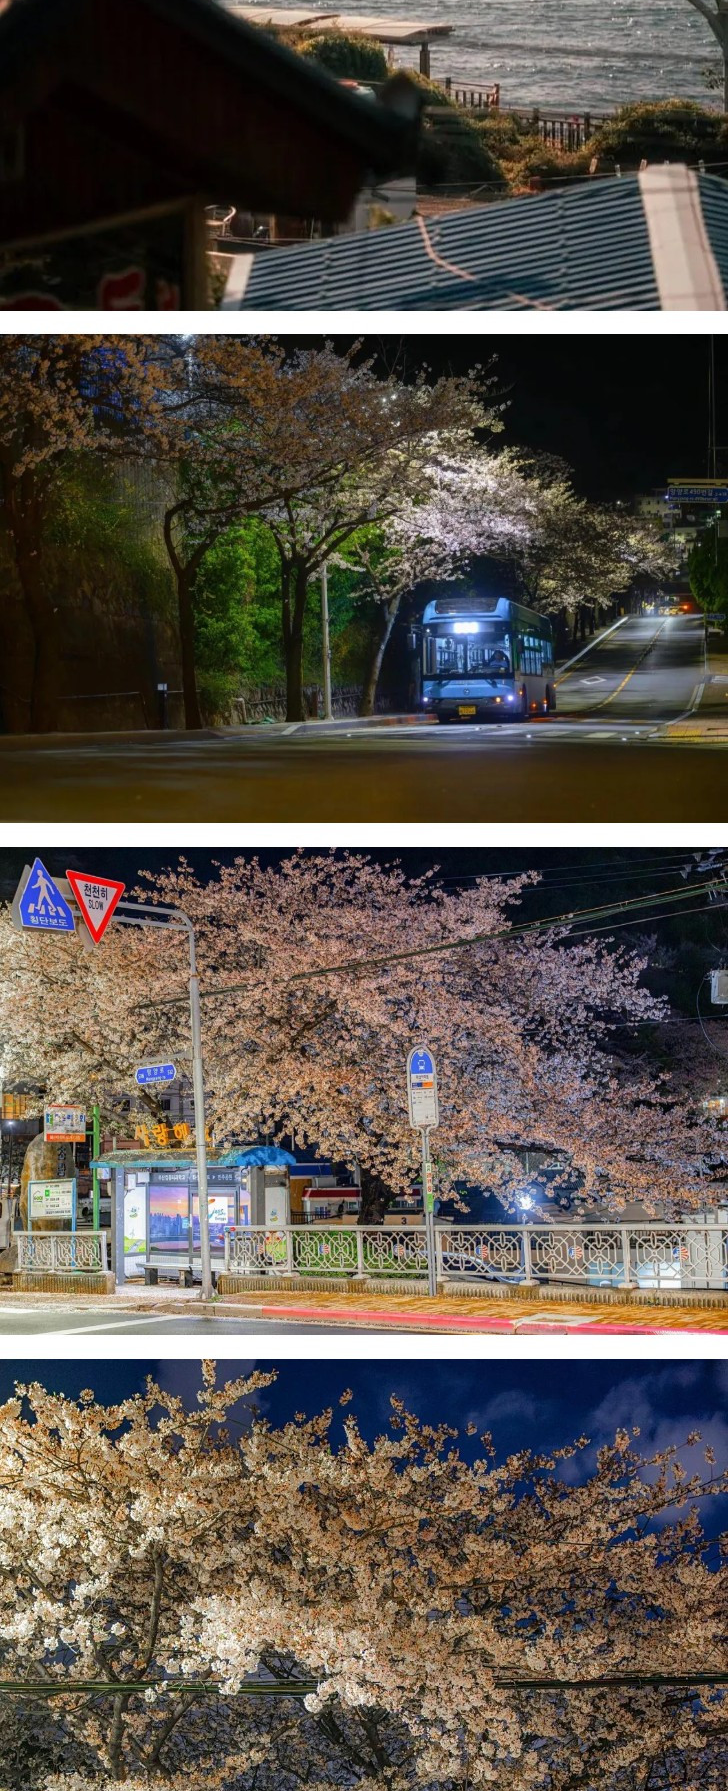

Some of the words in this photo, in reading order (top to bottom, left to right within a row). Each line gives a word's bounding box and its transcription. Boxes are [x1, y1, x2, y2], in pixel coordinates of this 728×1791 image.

[83, 883, 108, 900] 천천히
[88, 899, 104, 911] SLOW
[29, 915, 68, 926] 횡단보도
